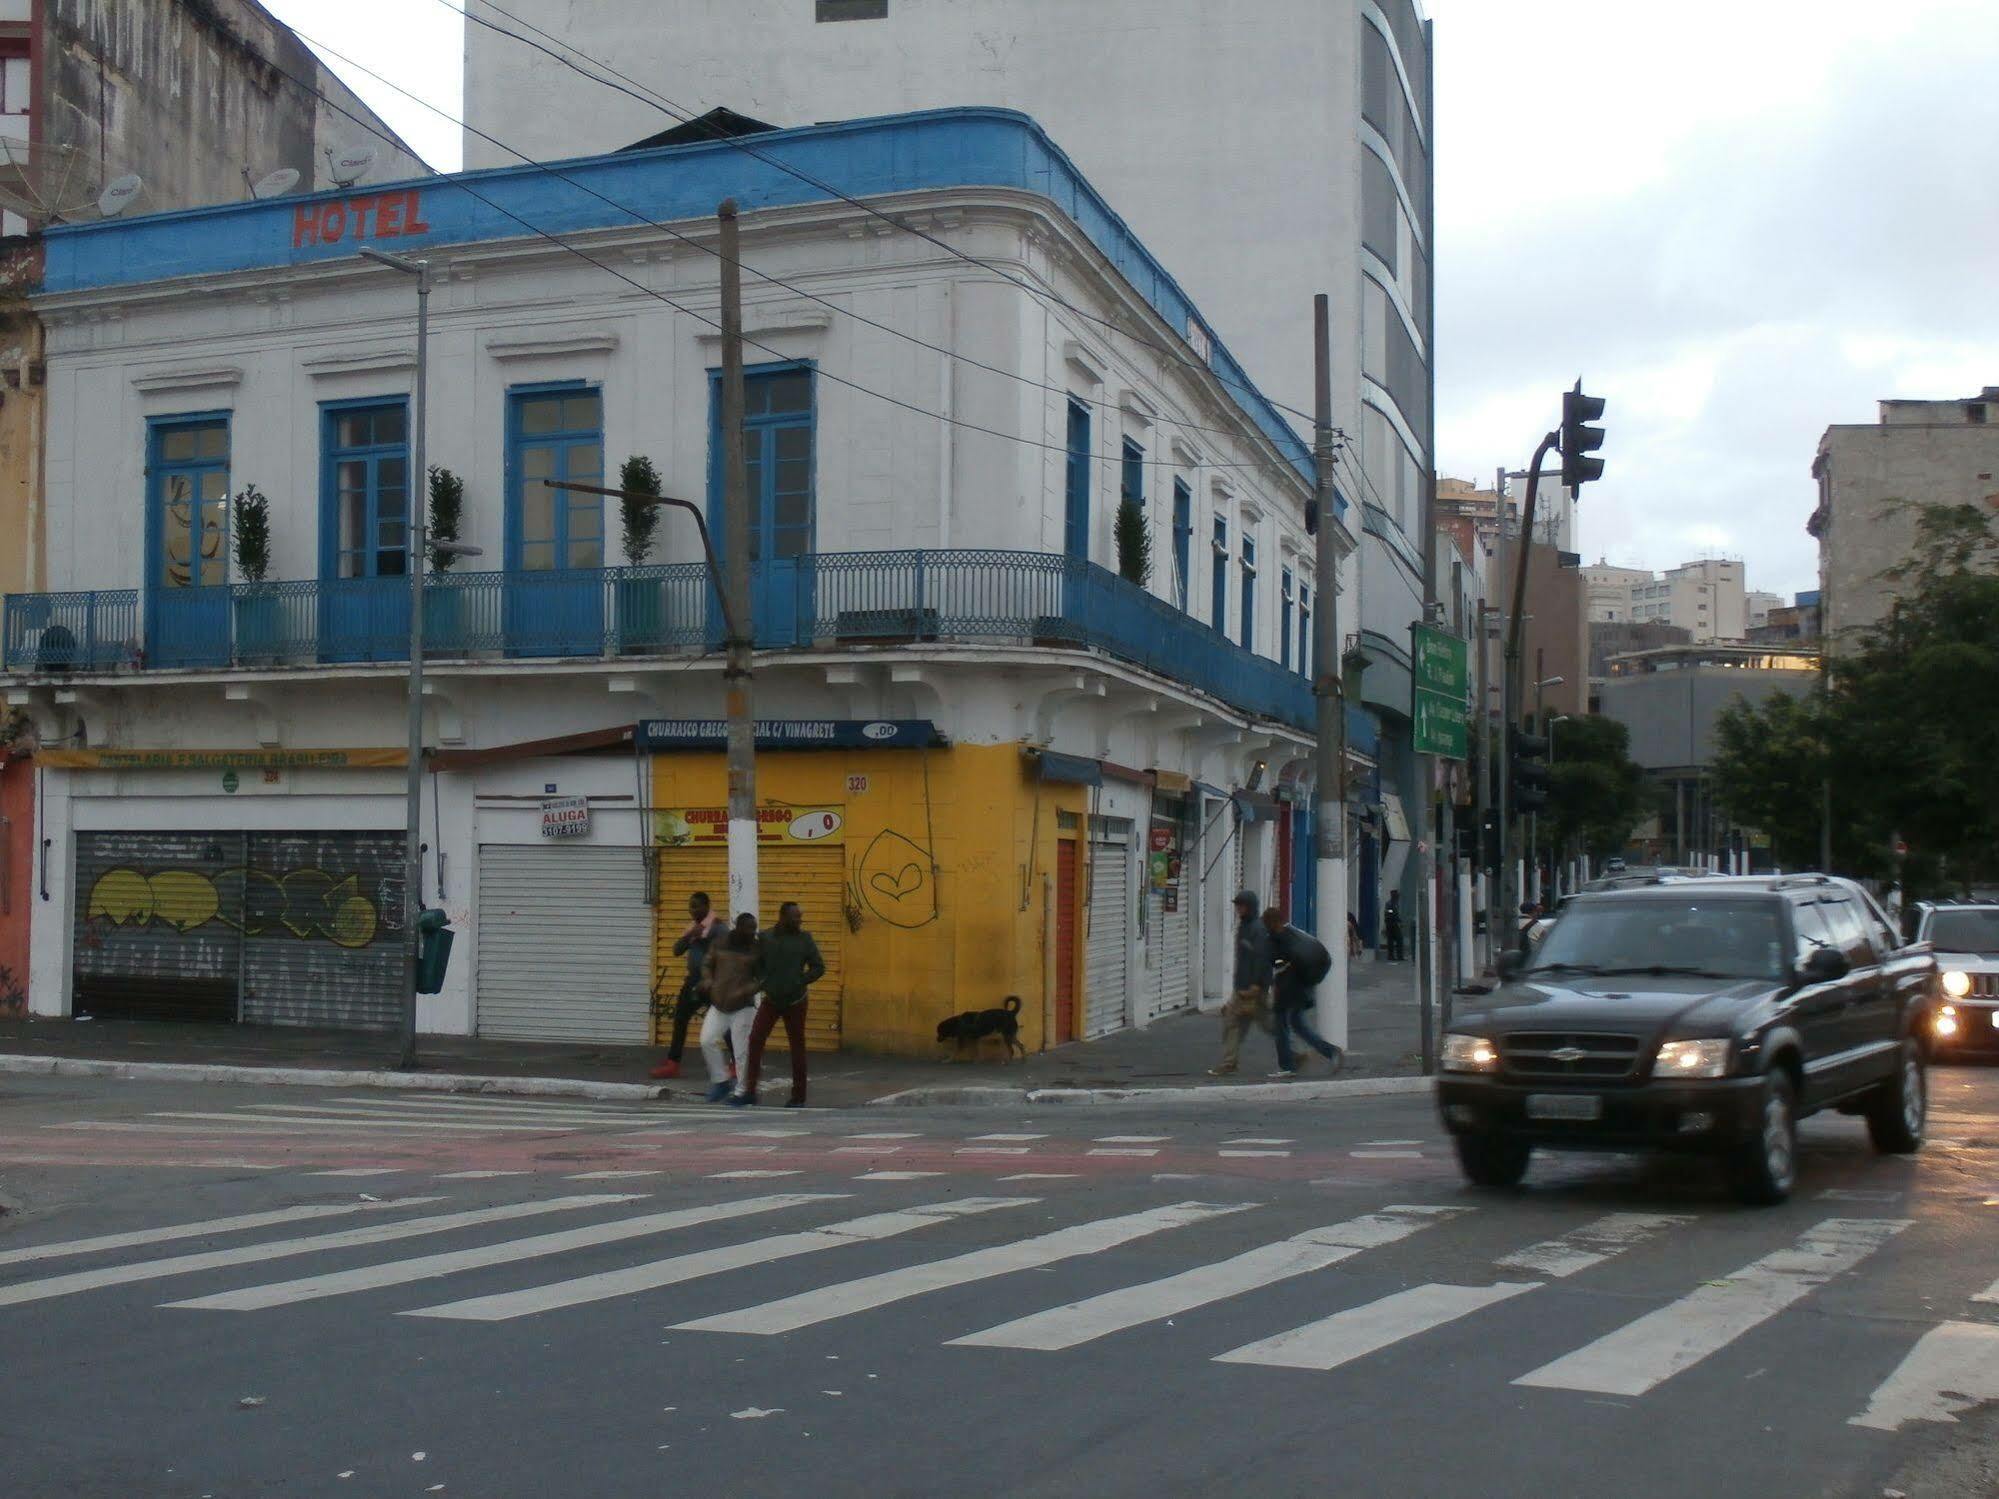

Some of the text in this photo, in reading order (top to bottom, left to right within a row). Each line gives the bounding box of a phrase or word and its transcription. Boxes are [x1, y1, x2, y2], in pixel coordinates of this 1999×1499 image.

[293, 191, 430, 249] HOTEL
[648, 722, 698, 737] CHURRASCO
[785, 722, 835, 738] VINAGRETE
[848, 777, 867, 790] 320
[543, 810, 586, 824] ALUGA
